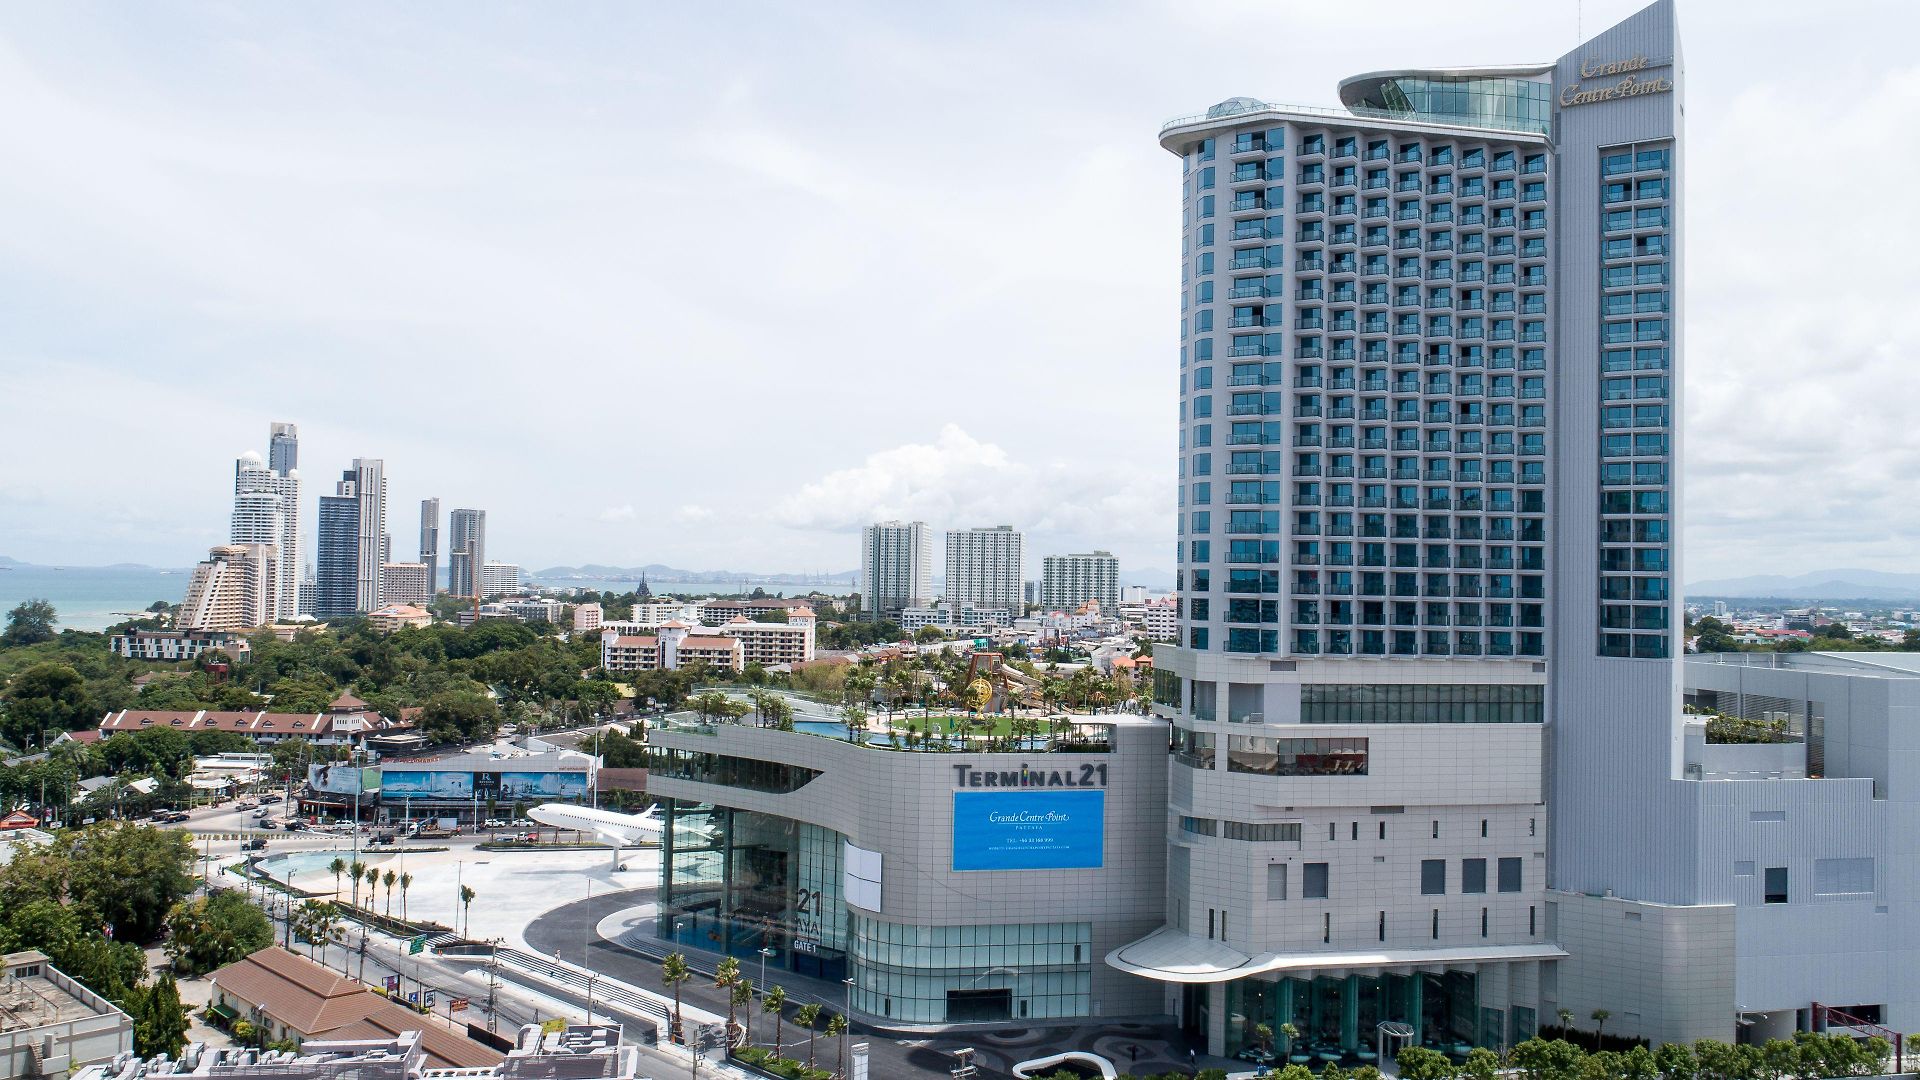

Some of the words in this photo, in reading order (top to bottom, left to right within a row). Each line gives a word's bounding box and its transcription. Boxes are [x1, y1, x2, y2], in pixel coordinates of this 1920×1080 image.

[1580, 55, 1649, 79] Grande
[1560, 84, 1614, 107] Centre
[1616, 74, 1673, 97] Point
[989, 811, 1019, 822] Grande
[1019, 810, 1044, 822] Centre
[1045, 810, 1070, 822] Point
[798, 888, 821, 916] 21
[794, 940, 812, 952] GATE
[812, 944, 817, 953] 1
